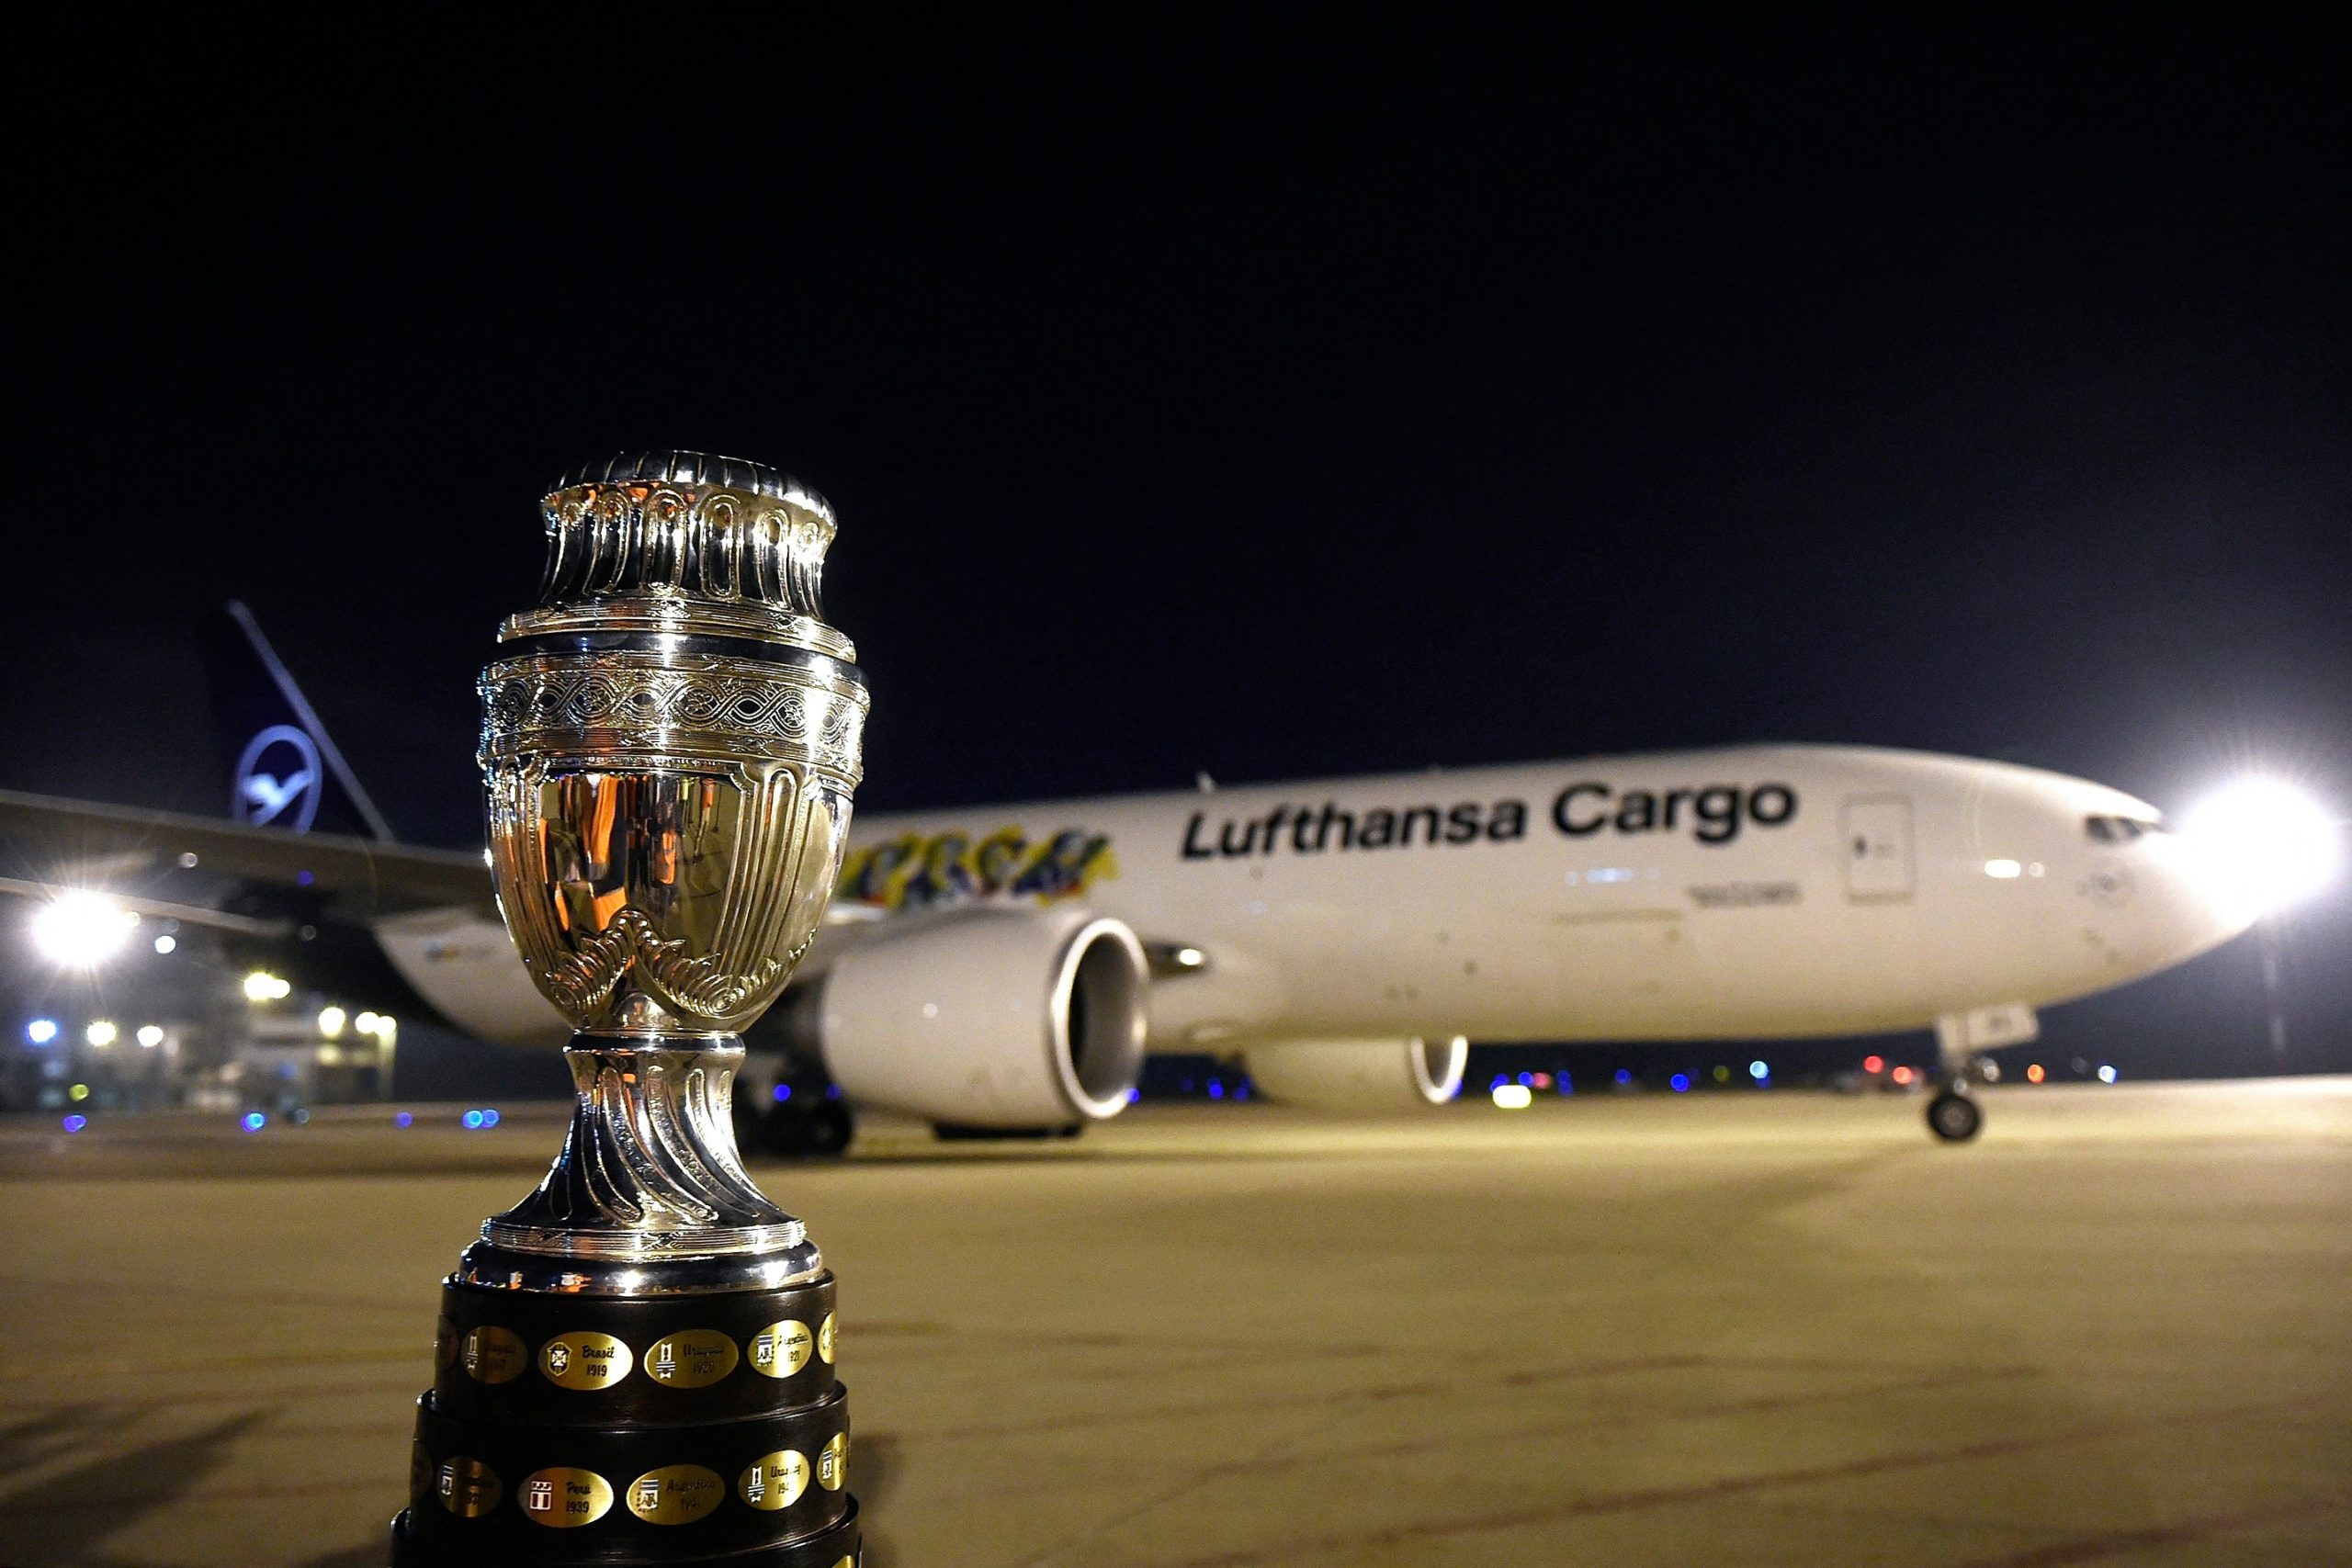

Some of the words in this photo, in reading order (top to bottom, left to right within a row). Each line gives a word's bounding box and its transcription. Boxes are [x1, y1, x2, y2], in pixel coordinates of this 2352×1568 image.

[1180, 797, 1528, 862] Lufthansa
[1551, 781, 1799, 846] Cargo
[582, 1345, 615, 1359] Brasil
[586, 1364, 607, 1377] 1919
[566, 1501, 589, 1514] 1939
